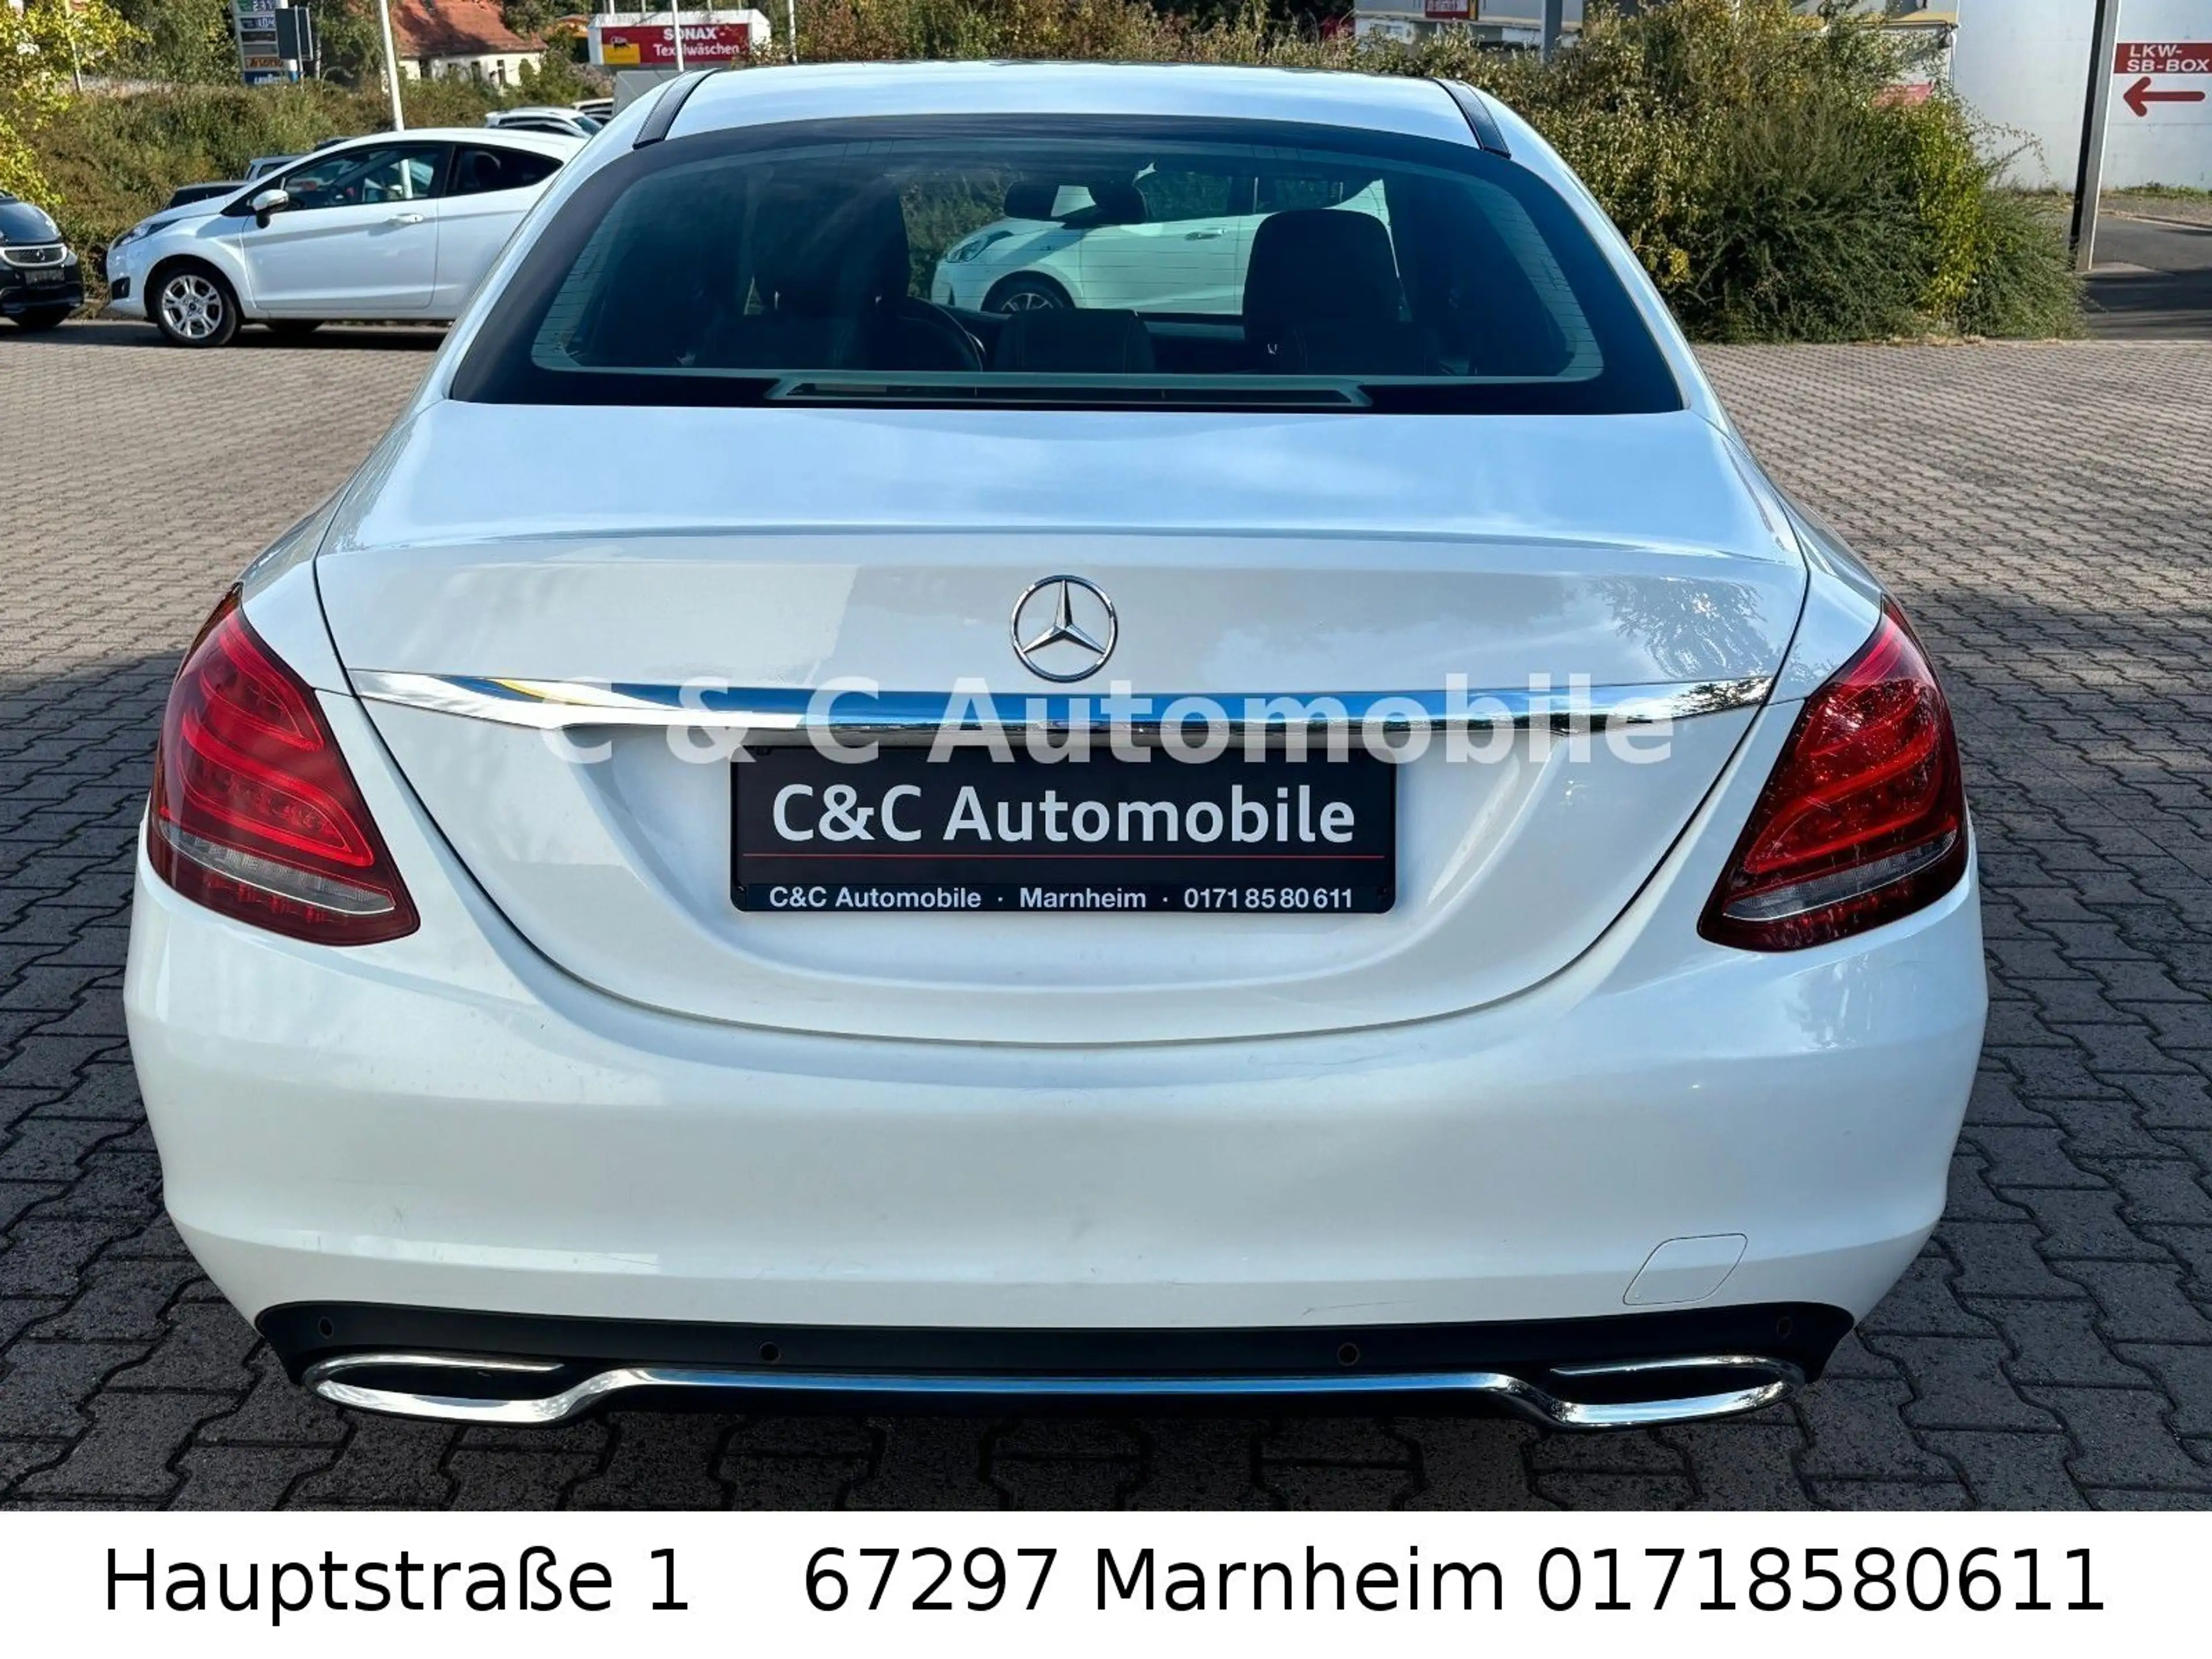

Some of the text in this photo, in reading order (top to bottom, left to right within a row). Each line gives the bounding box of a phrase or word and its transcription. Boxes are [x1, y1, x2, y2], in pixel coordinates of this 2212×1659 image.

[653, 41, 740, 56] Texlwäschen
[2130, 44, 2183, 58] LKW-
[2126, 58, 2210, 72] SB-BOX
[773, 784, 1354, 843] C&C Automobile
[770, 886, 827, 908] C&C
[835, 887, 982, 908] Automobile
[1020, 887, 1146, 908] Marnheim
